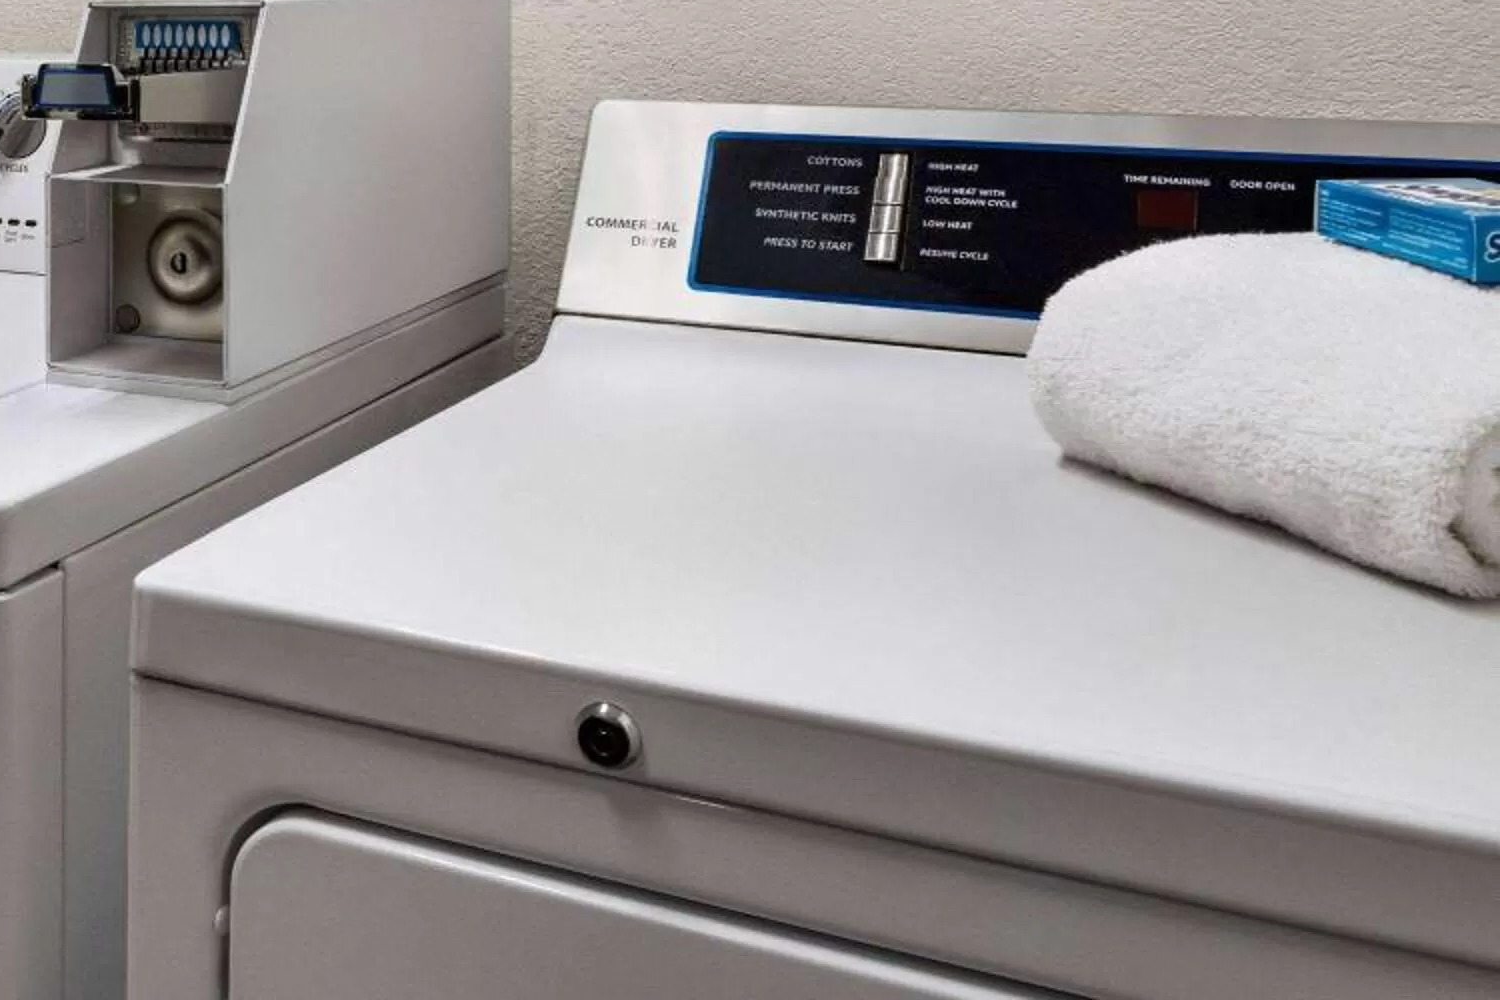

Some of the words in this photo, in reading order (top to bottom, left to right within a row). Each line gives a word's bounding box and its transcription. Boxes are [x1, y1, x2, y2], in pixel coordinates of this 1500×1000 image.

[807, 155, 863, 167] COTTONS
[1124, 174, 1148, 184] TIME
[1150, 175, 1211, 187] REMAINING
[1229, 179, 1262, 189] DOOR
[1265, 181, 1296, 191] OPEN
[749, 180, 821, 193] PERMANENT
[823, 184, 860, 195] PRESS
[979, 188, 1006, 197] WITH
[925, 196, 951, 205] COOL
[953, 197, 986, 207] DOWN
[987, 199, 1018, 208] CYCLE
[755, 207, 819, 221] SYNTHETIC
[821, 211, 857, 223] KNITS
[586, 216, 680, 233] COMMERIAL
[923, 220, 946, 229] LOW
[947, 221, 973, 230] HEAT
[764, 236, 798, 248] PRESS
[801, 239, 816, 248] TO
[818, 240, 853, 251] START
[959, 251, 990, 261] CYCLE
